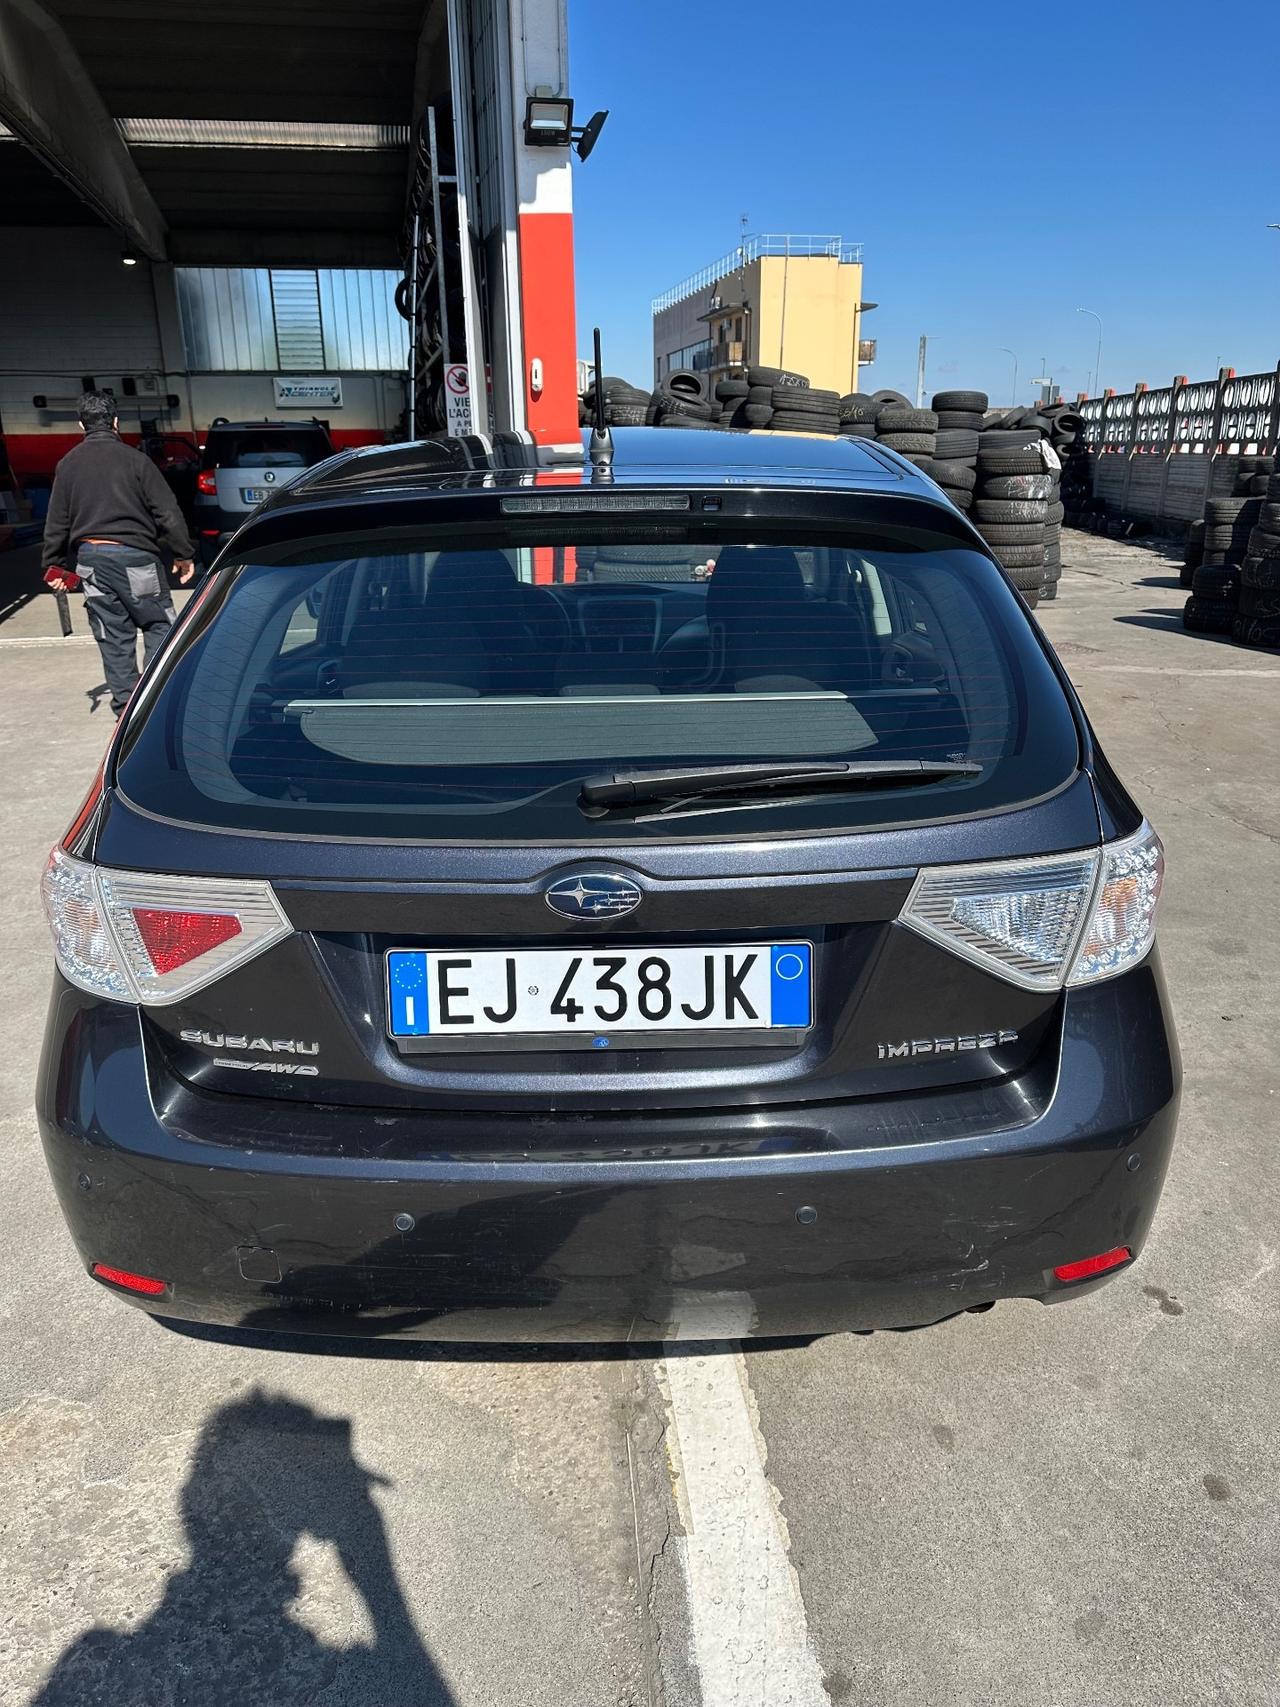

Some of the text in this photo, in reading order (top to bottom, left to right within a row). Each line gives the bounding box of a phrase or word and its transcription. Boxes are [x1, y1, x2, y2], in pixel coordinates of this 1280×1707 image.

[449, 409, 471, 418] L'AC
[437, 953, 760, 1025] EJ 438JK
[179, 1029, 320, 1056] SUBARU
[877, 1030, 1019, 1059] IMPREZA
[251, 1063, 320, 1076] AWD
